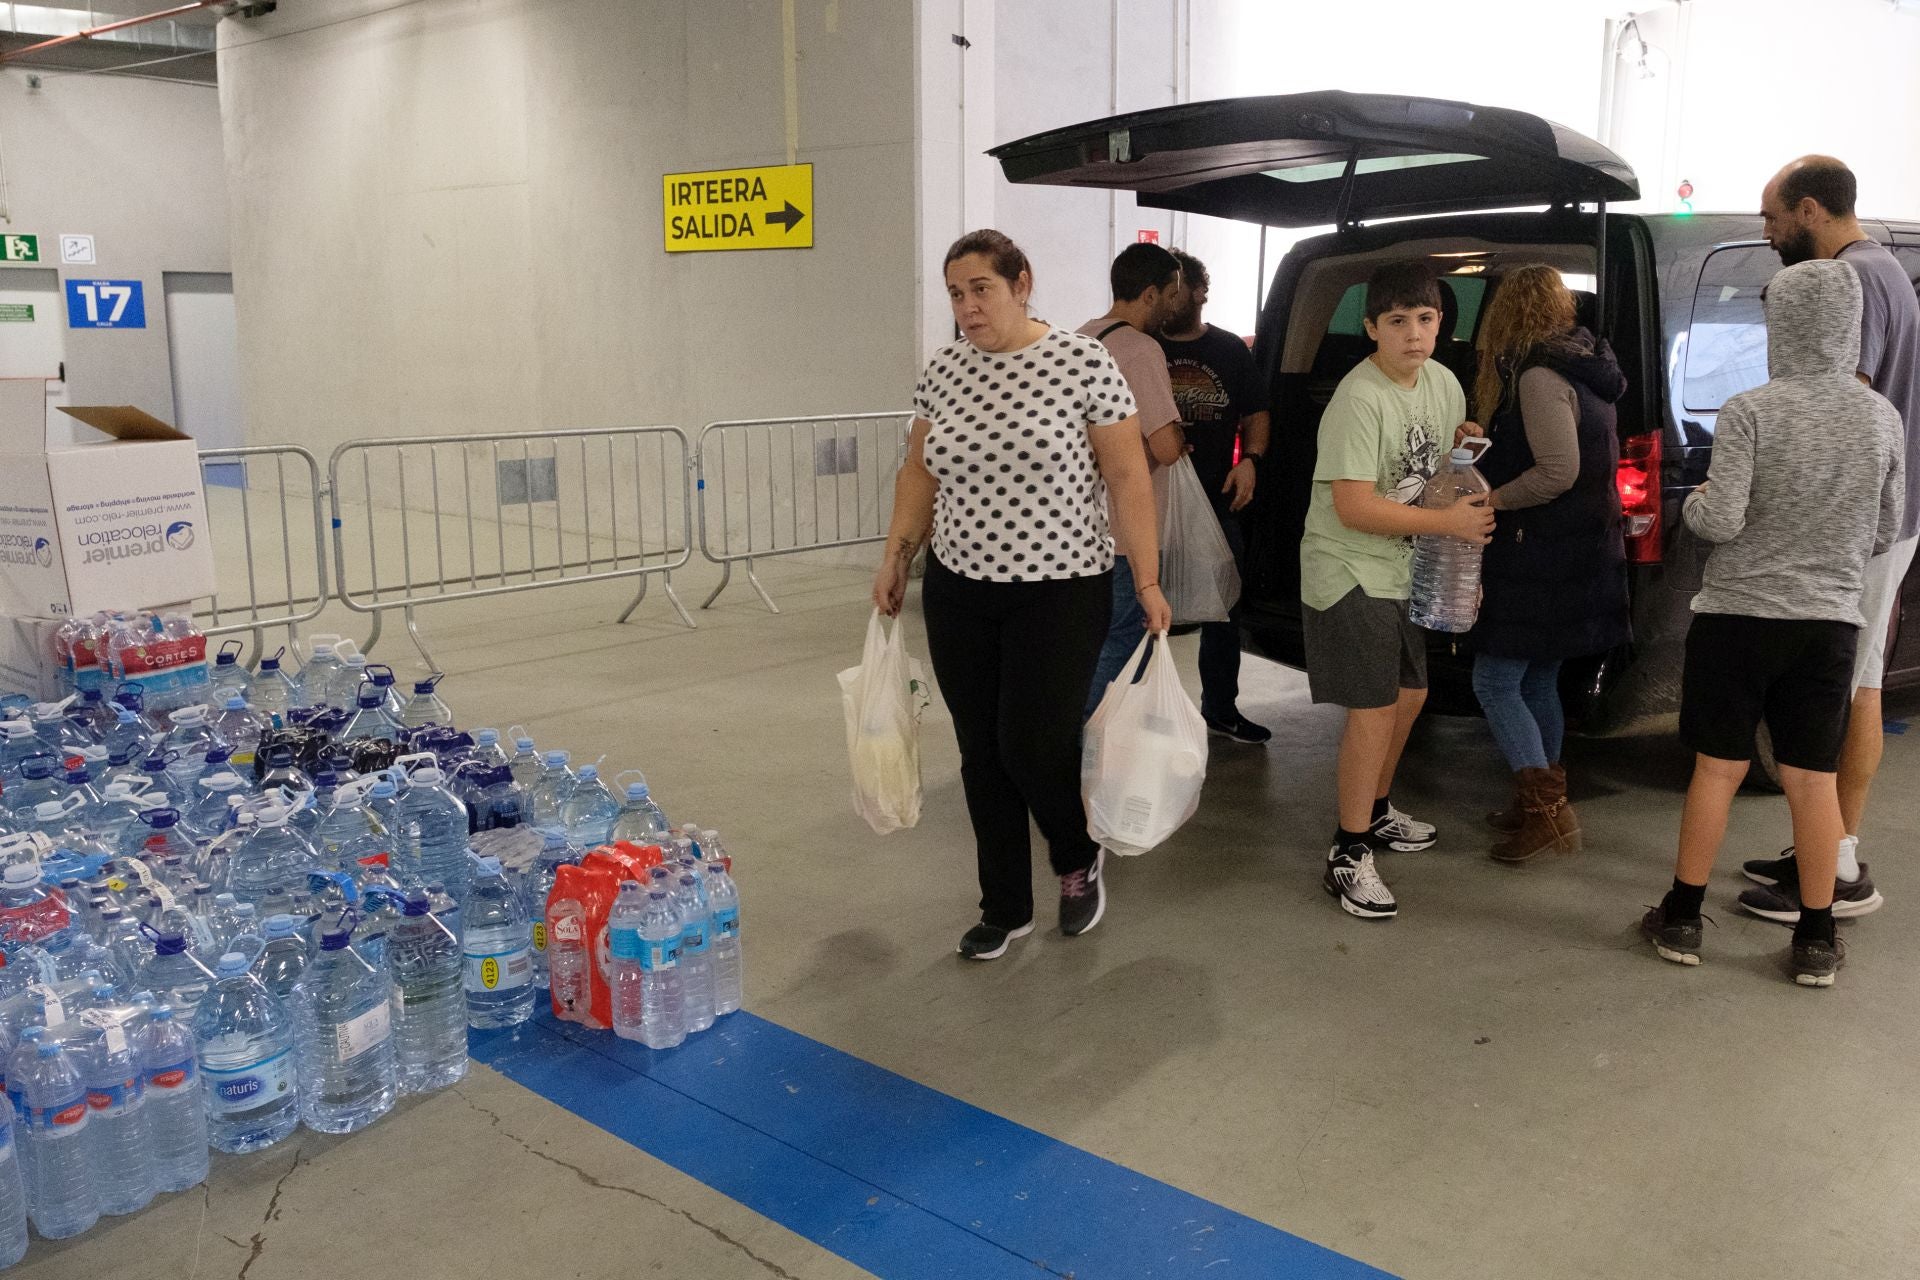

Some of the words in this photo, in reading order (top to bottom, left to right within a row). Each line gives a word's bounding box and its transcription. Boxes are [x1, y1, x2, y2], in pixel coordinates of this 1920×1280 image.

[671, 176, 767, 206] IRTEERA
[671, 212, 754, 240] SALIDA
[77, 285, 132, 322] 17
[1201, 364, 1219, 380] RIDE
[66, 503, 94, 512] storage
[136, 495, 161, 505] moving
[74, 503, 192, 525] www.premier-relo.com
[77, 523, 163, 546] relocation
[0, 548, 36, 566] premie
[82, 535, 165, 565] premier
[145, 646, 198, 666] CORTES
[485, 961, 495, 985] 4123
[220, 1080, 259, 1096] naturis
